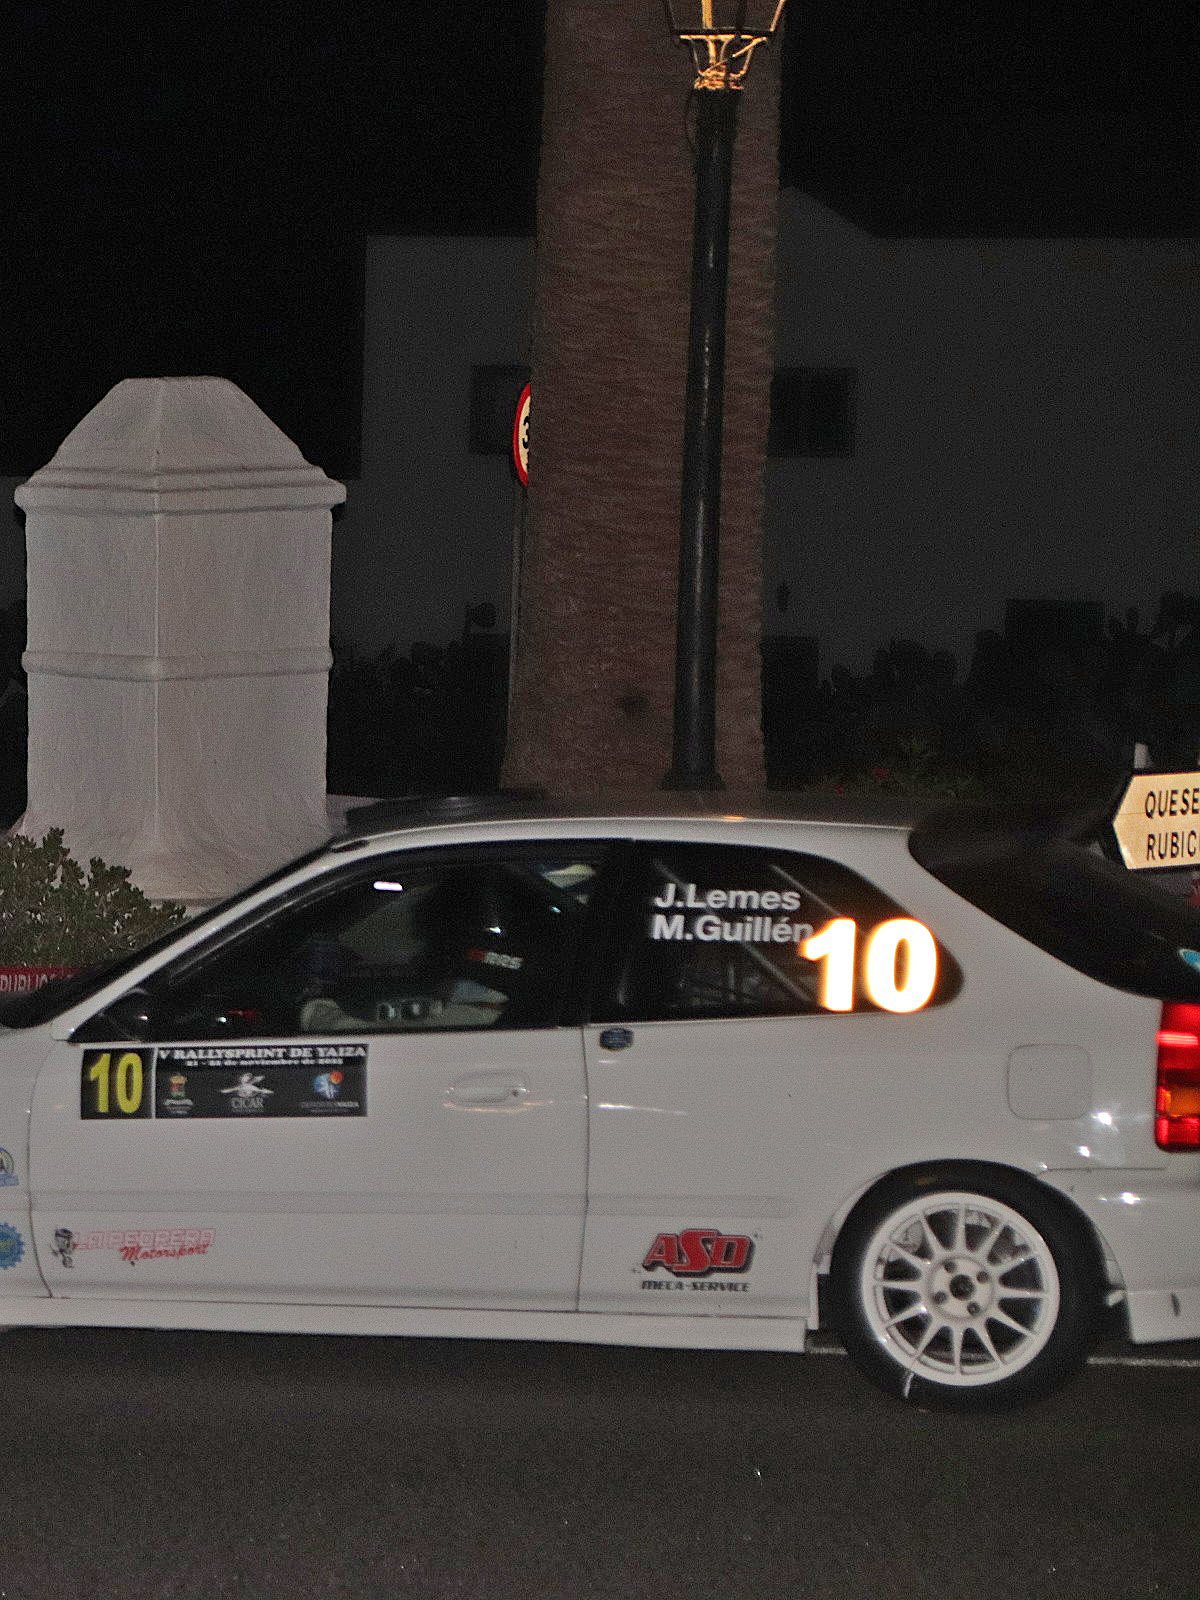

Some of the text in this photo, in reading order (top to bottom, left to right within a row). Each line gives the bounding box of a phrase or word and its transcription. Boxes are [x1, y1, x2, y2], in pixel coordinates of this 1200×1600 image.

[1146, 829, 1200, 861] RUBIC
[654, 883, 801, 911] J.Lemes
[652, 914, 814, 943] M.Guillén
[801, 917, 938, 1013] 10
[160, 1046, 367, 1059] V RALLYSPRINT DE YAIZA
[88, 1053, 143, 1114] 10
[642, 1229, 755, 1277] ASD
